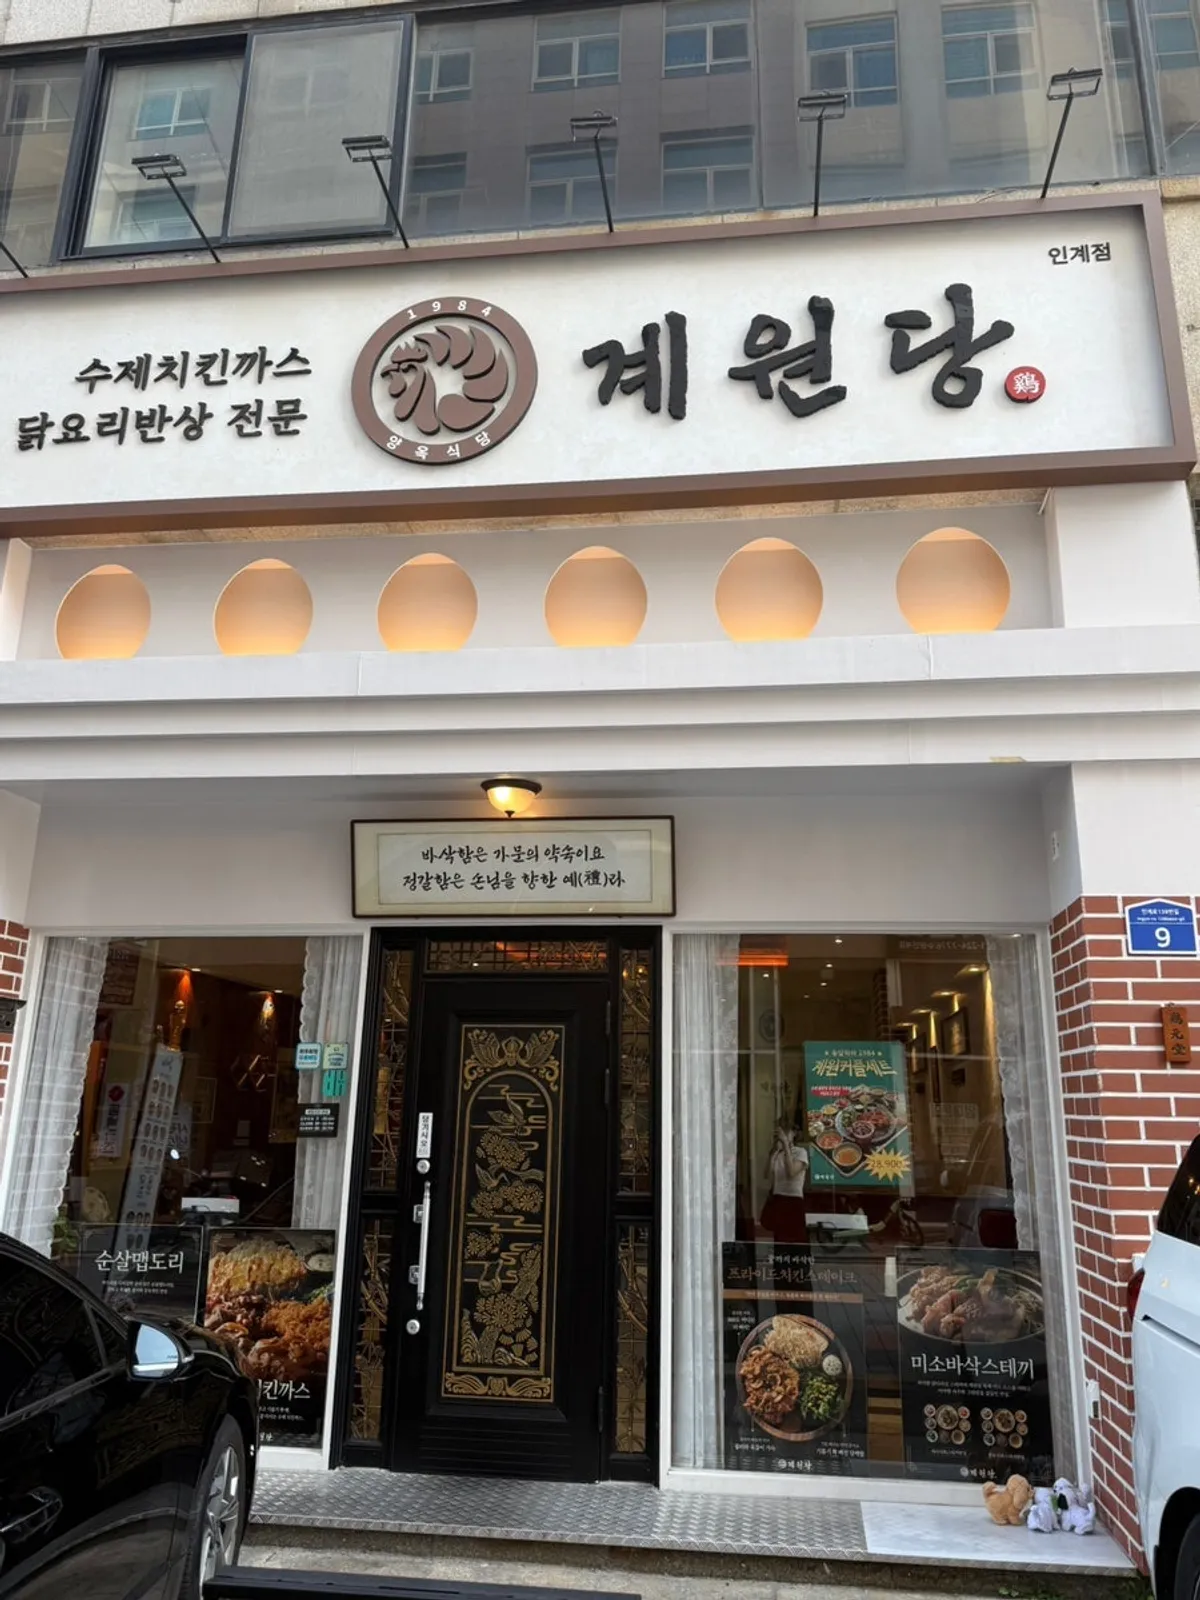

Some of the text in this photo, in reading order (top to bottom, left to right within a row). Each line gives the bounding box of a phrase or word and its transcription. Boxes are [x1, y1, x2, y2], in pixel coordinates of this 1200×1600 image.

[1047, 241, 1112, 265] 인계점
[405, 299, 492, 320] 1984
[582, 282, 1014, 421] 계원당
[75, 345, 312, 394] 수제치킨까스
[17, 397, 308, 451] 닭요리반상 전문
[386, 431, 491, 460] 양옥식당
[421, 844, 488, 864] 바삭함은
[494, 844, 539, 863] 가문의
[403, 870, 464, 891] 정갈함은
[470, 871, 516, 890] 손님을
[521, 871, 557, 890] 향한
[1154, 926, 1171, 948] 9
[812, 1058, 898, 1078] 계원커플세트
[94, 1249, 184, 1274] 순살맵도리
[911, 1353, 1035, 1380] 미소바삭스테끼
[258, 1379, 311, 1400] 킨까스
